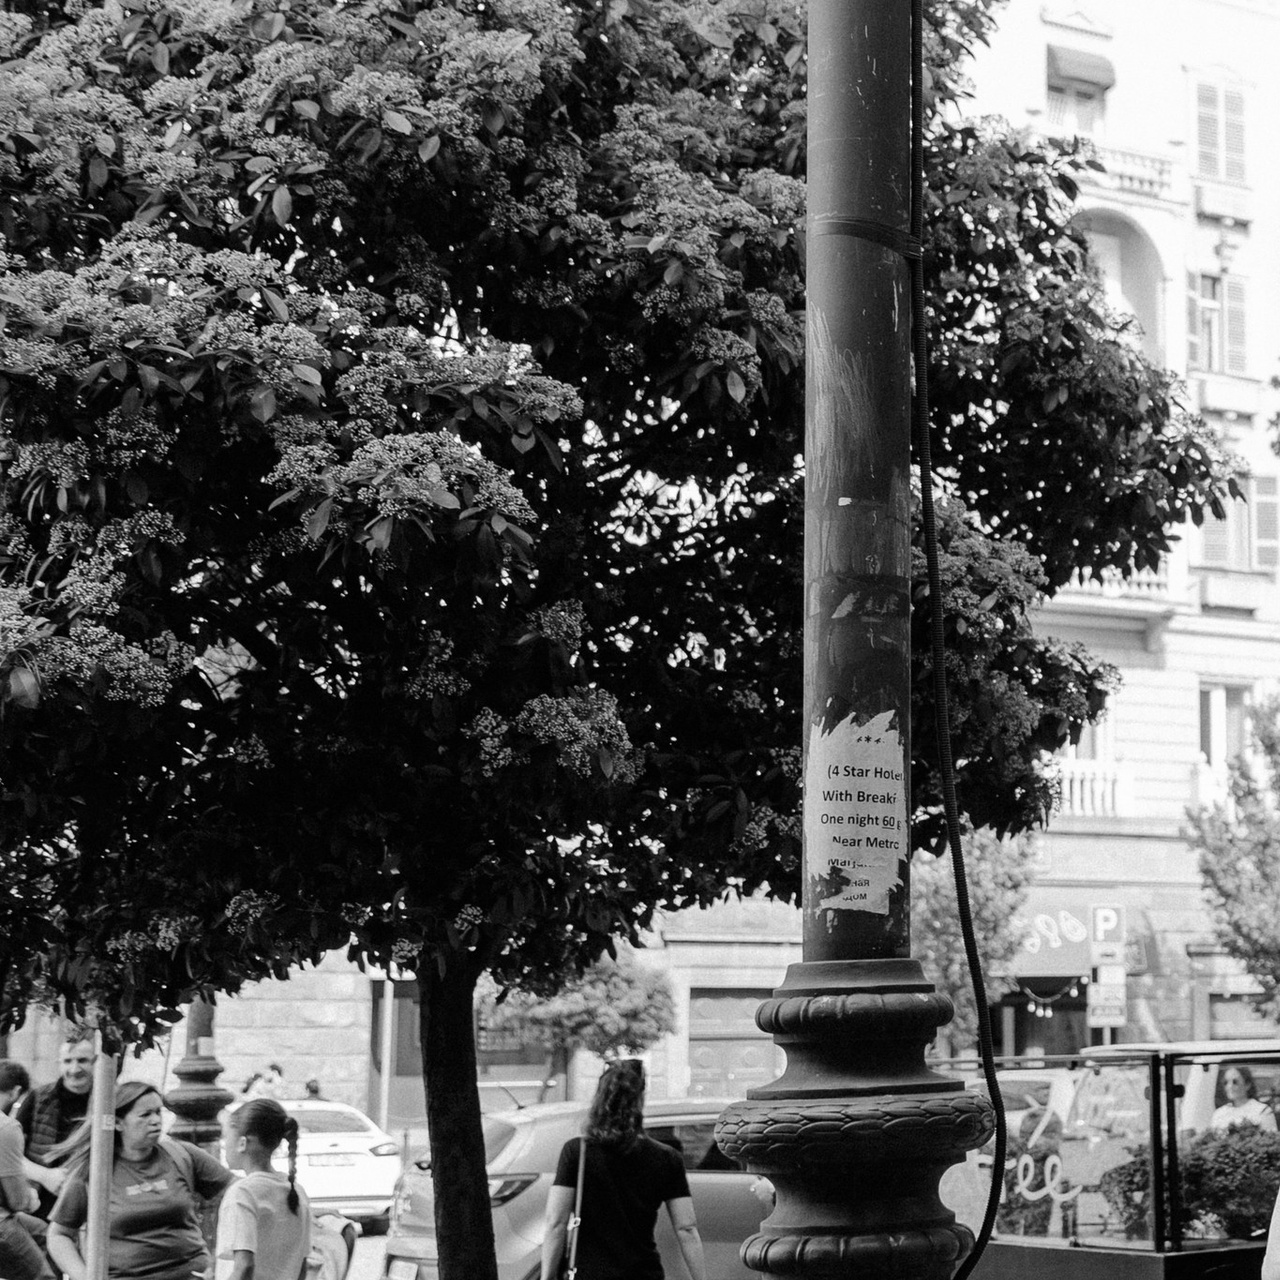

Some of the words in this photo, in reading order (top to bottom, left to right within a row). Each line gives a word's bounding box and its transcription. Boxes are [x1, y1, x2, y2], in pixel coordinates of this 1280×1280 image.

[827, 764, 840, 780] (4
[843, 765, 871, 778] Star
[822, 789, 853, 802] With
[820, 813, 844, 825] One
[847, 813, 880, 828] night
[882, 815, 895, 827] 60
[832, 835, 863, 847] Near
[1095, 907, 1119, 942] P
